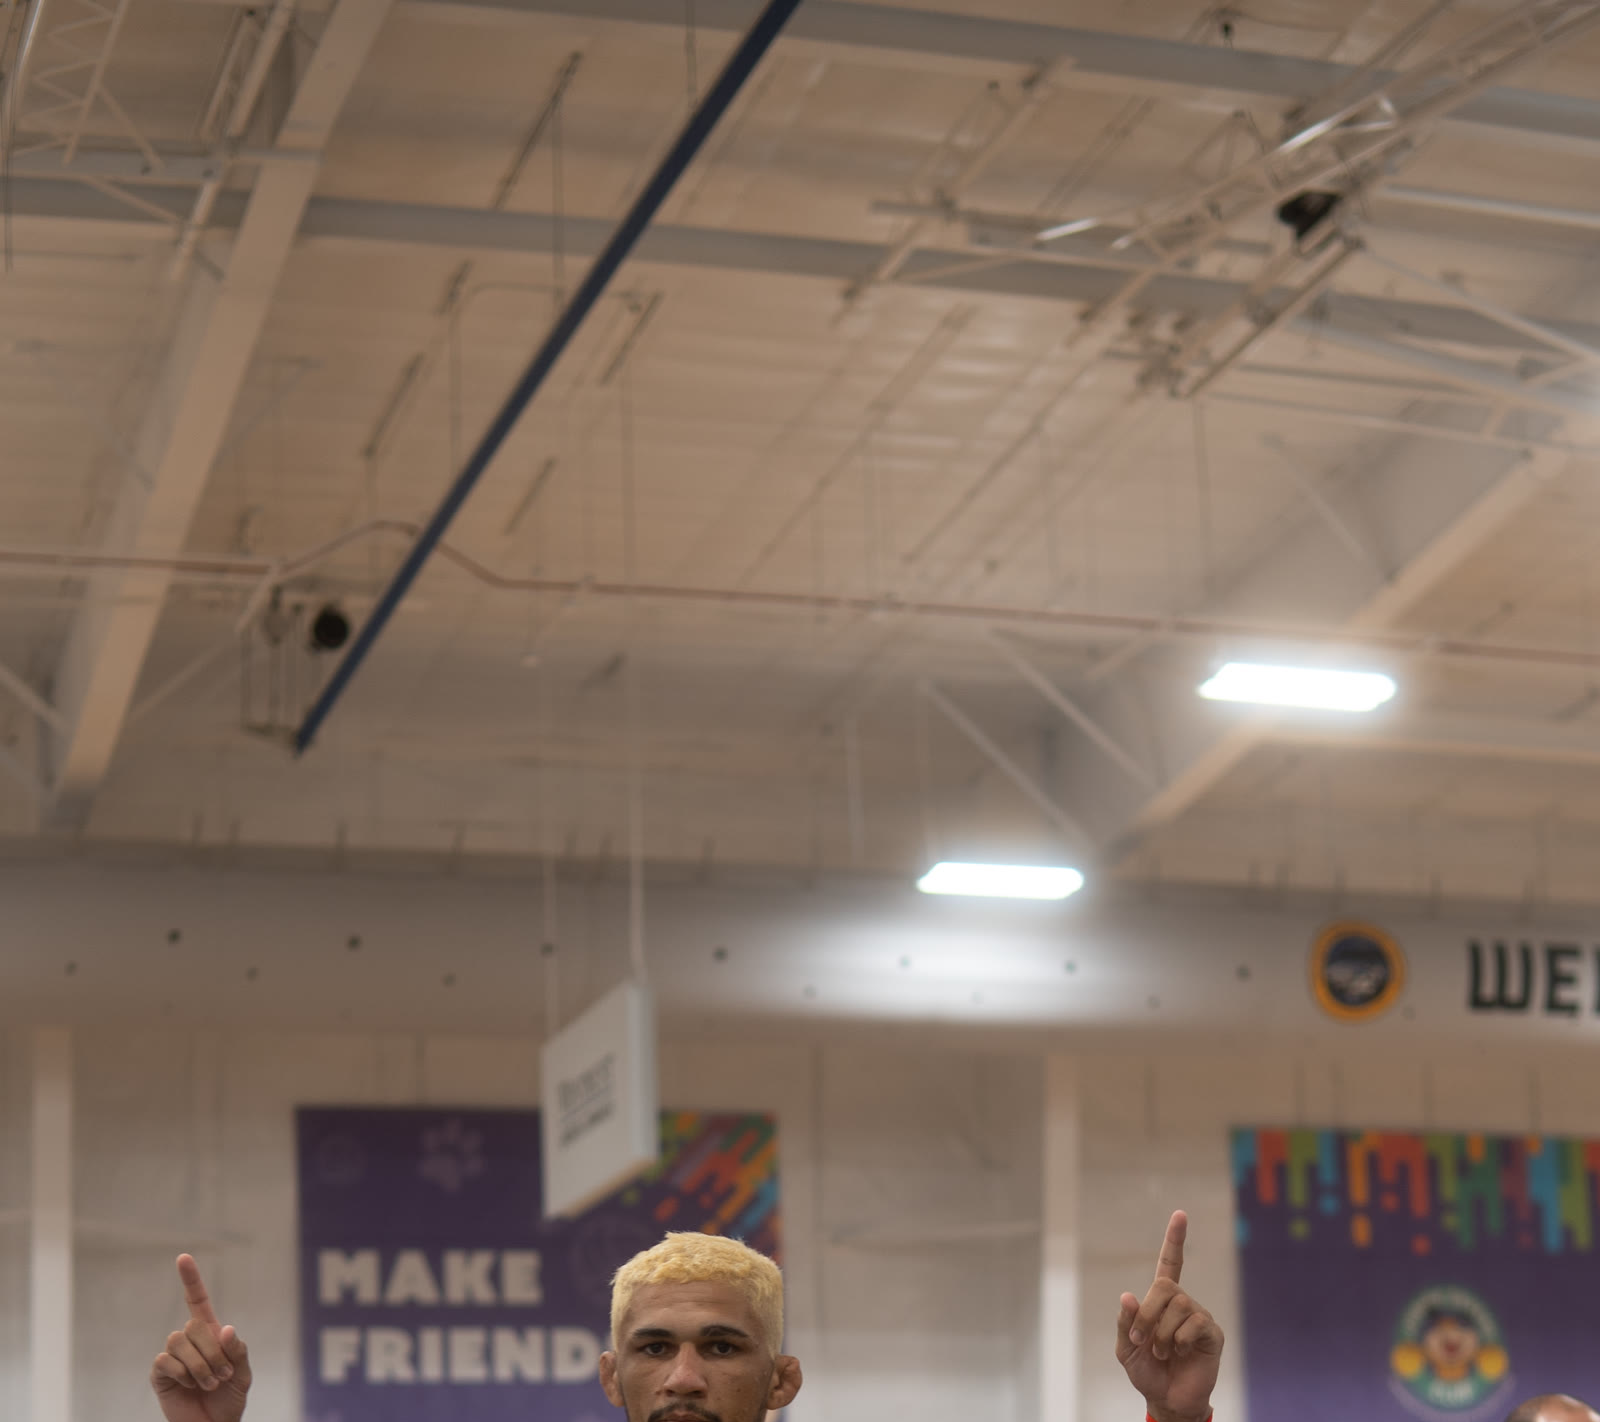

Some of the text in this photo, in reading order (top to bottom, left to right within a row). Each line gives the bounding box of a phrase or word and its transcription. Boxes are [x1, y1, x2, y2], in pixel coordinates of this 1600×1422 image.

[1468, 941, 1600, 1012] WE
[318, 1249, 543, 1305] MAKE
[320, 1327, 609, 1383] FRIEND
